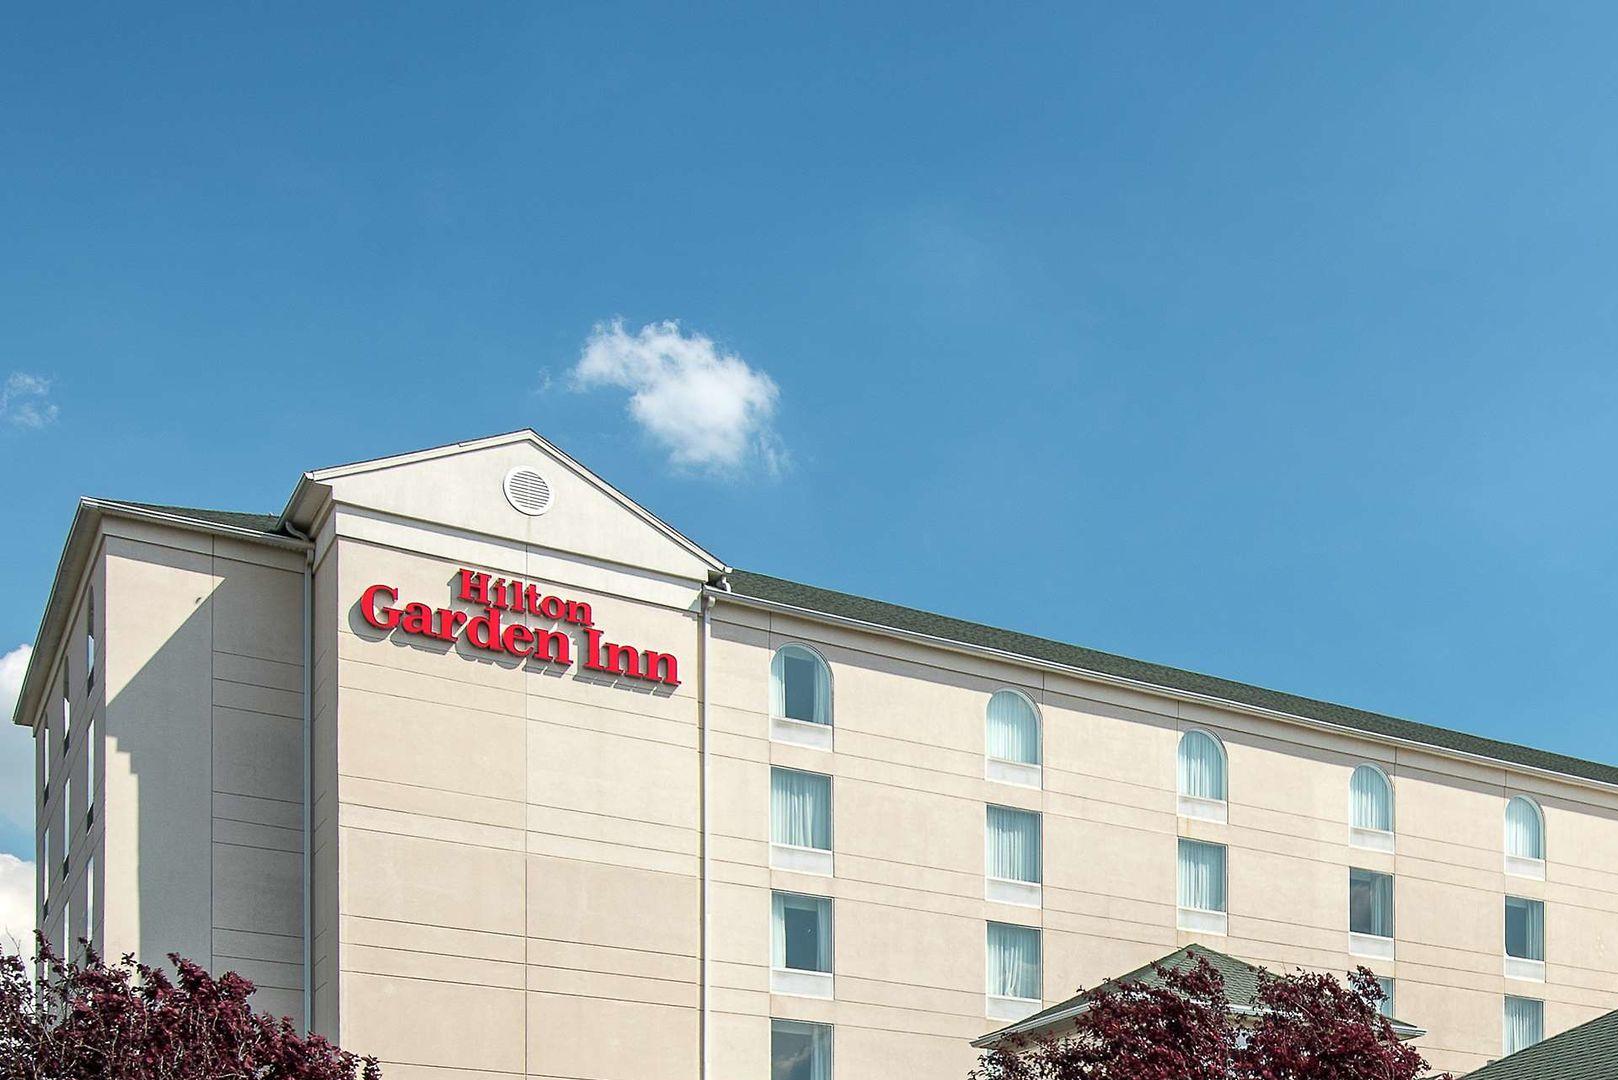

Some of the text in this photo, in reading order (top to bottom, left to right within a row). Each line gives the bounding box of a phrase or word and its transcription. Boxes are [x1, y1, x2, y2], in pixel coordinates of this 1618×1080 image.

[360, 584, 682, 686] Garden Inn
[457, 568, 595, 627] Hilton
